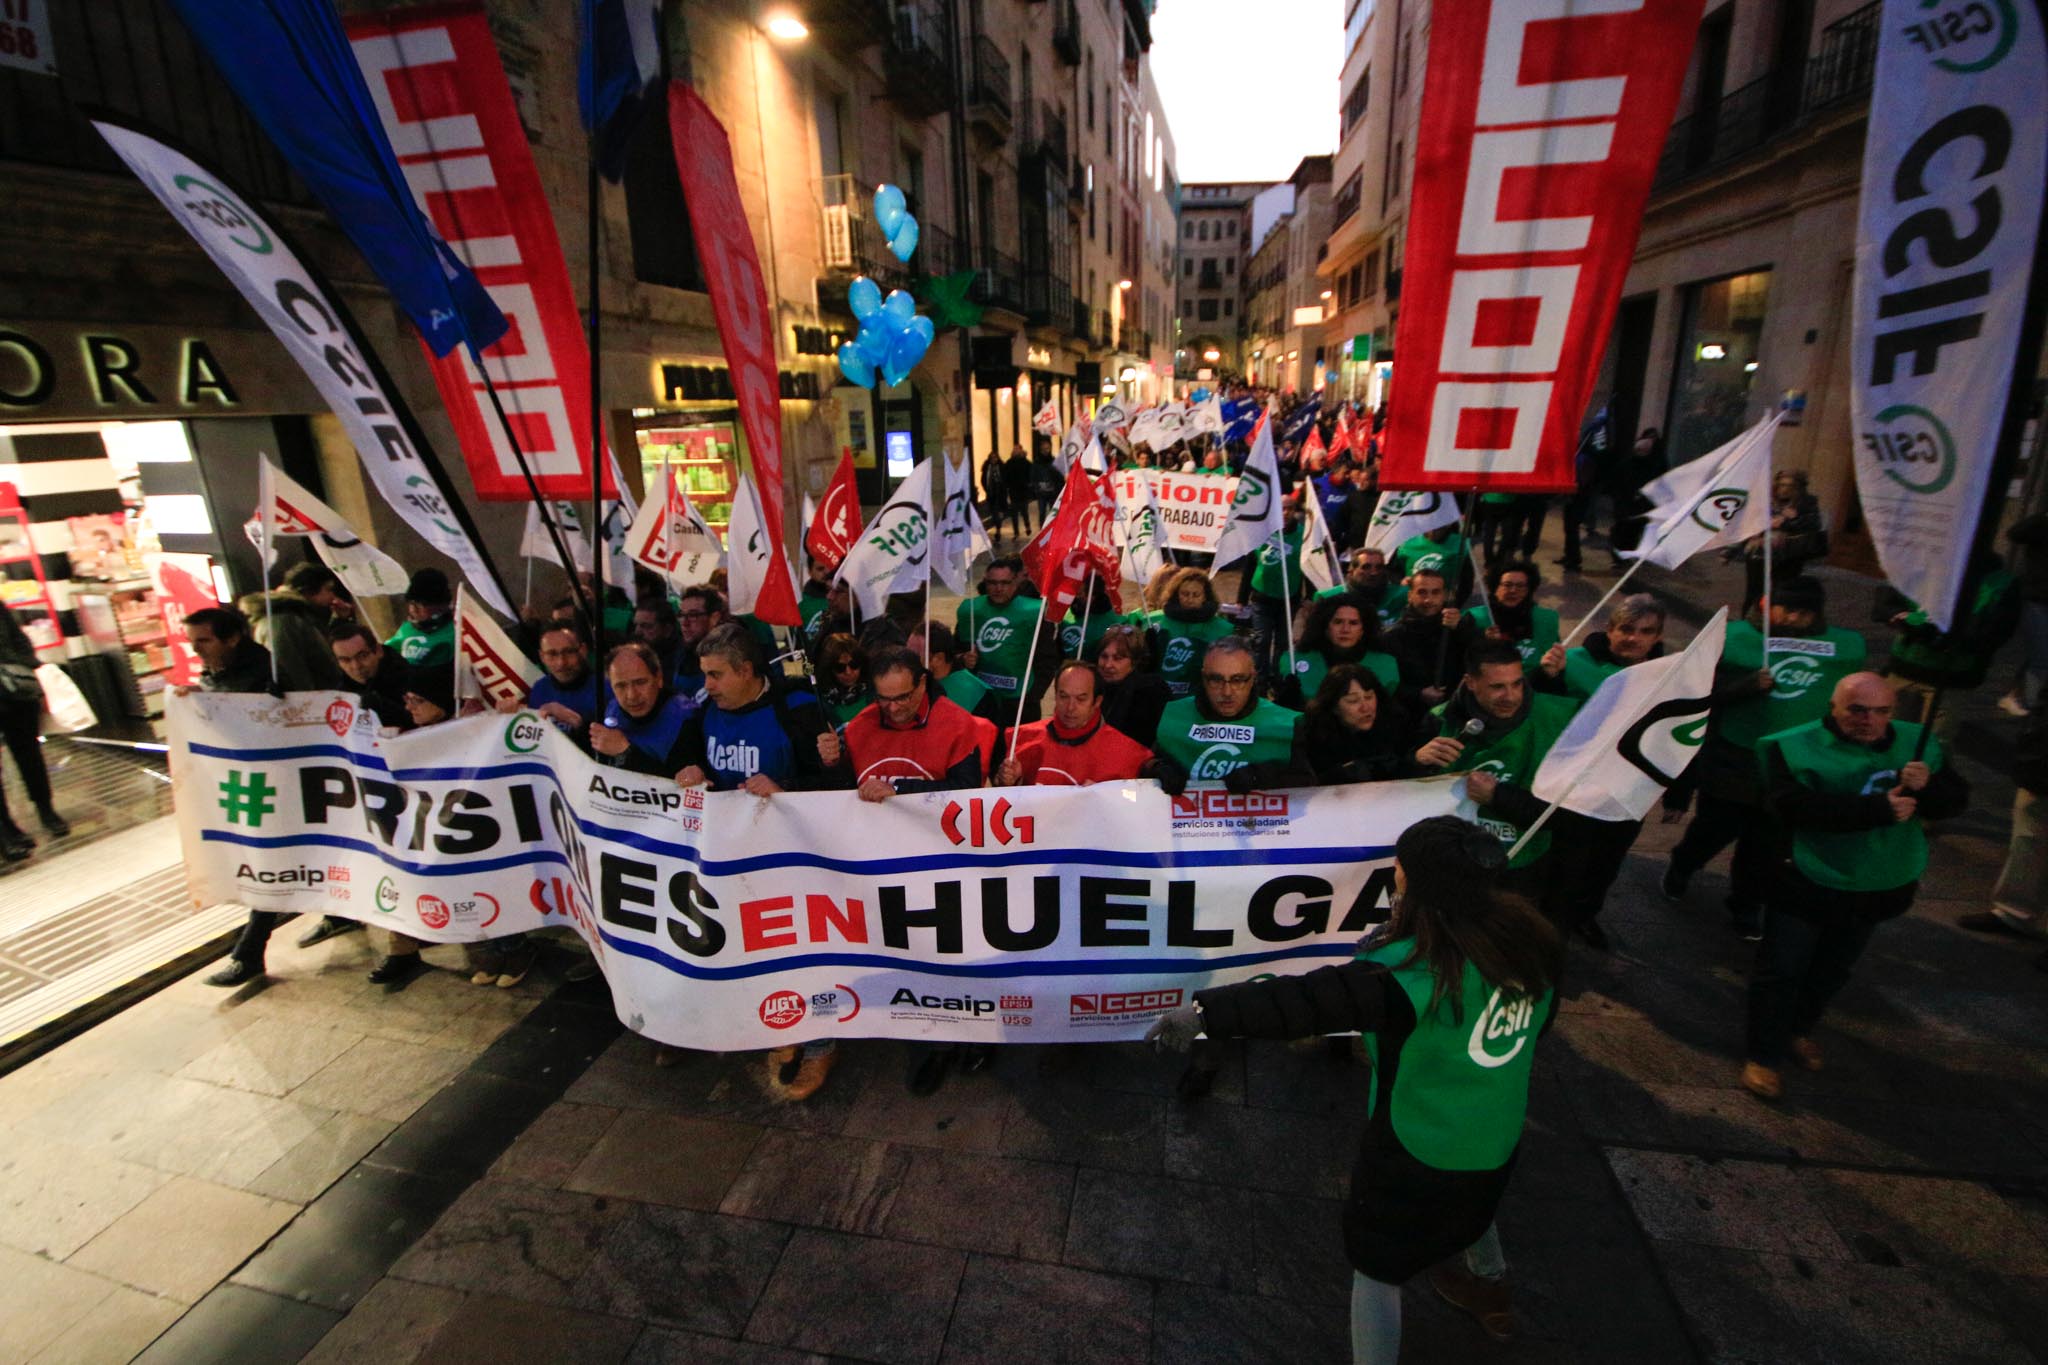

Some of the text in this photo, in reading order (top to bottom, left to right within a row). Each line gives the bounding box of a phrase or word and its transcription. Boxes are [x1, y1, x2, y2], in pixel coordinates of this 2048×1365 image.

[983, 628, 1014, 643] CSIF
[1776, 669, 1823, 687] CSIF
[515, 723, 544, 742] CSIF
[1193, 729, 1252, 742] PRISIONES
[589, 774, 682, 813] Acaip
[1205, 793, 1286, 814] CCOO
[940, 796, 1035, 848] CIG
[1172, 820, 1215, 829] servicios
[1225, 819, 1234, 828] la
[236, 864, 325, 887] Acaip
[764, 994, 803, 1014] UGT
[889, 988, 996, 1017] Acaip
[1105, 991, 1180, 1012] CCOO
